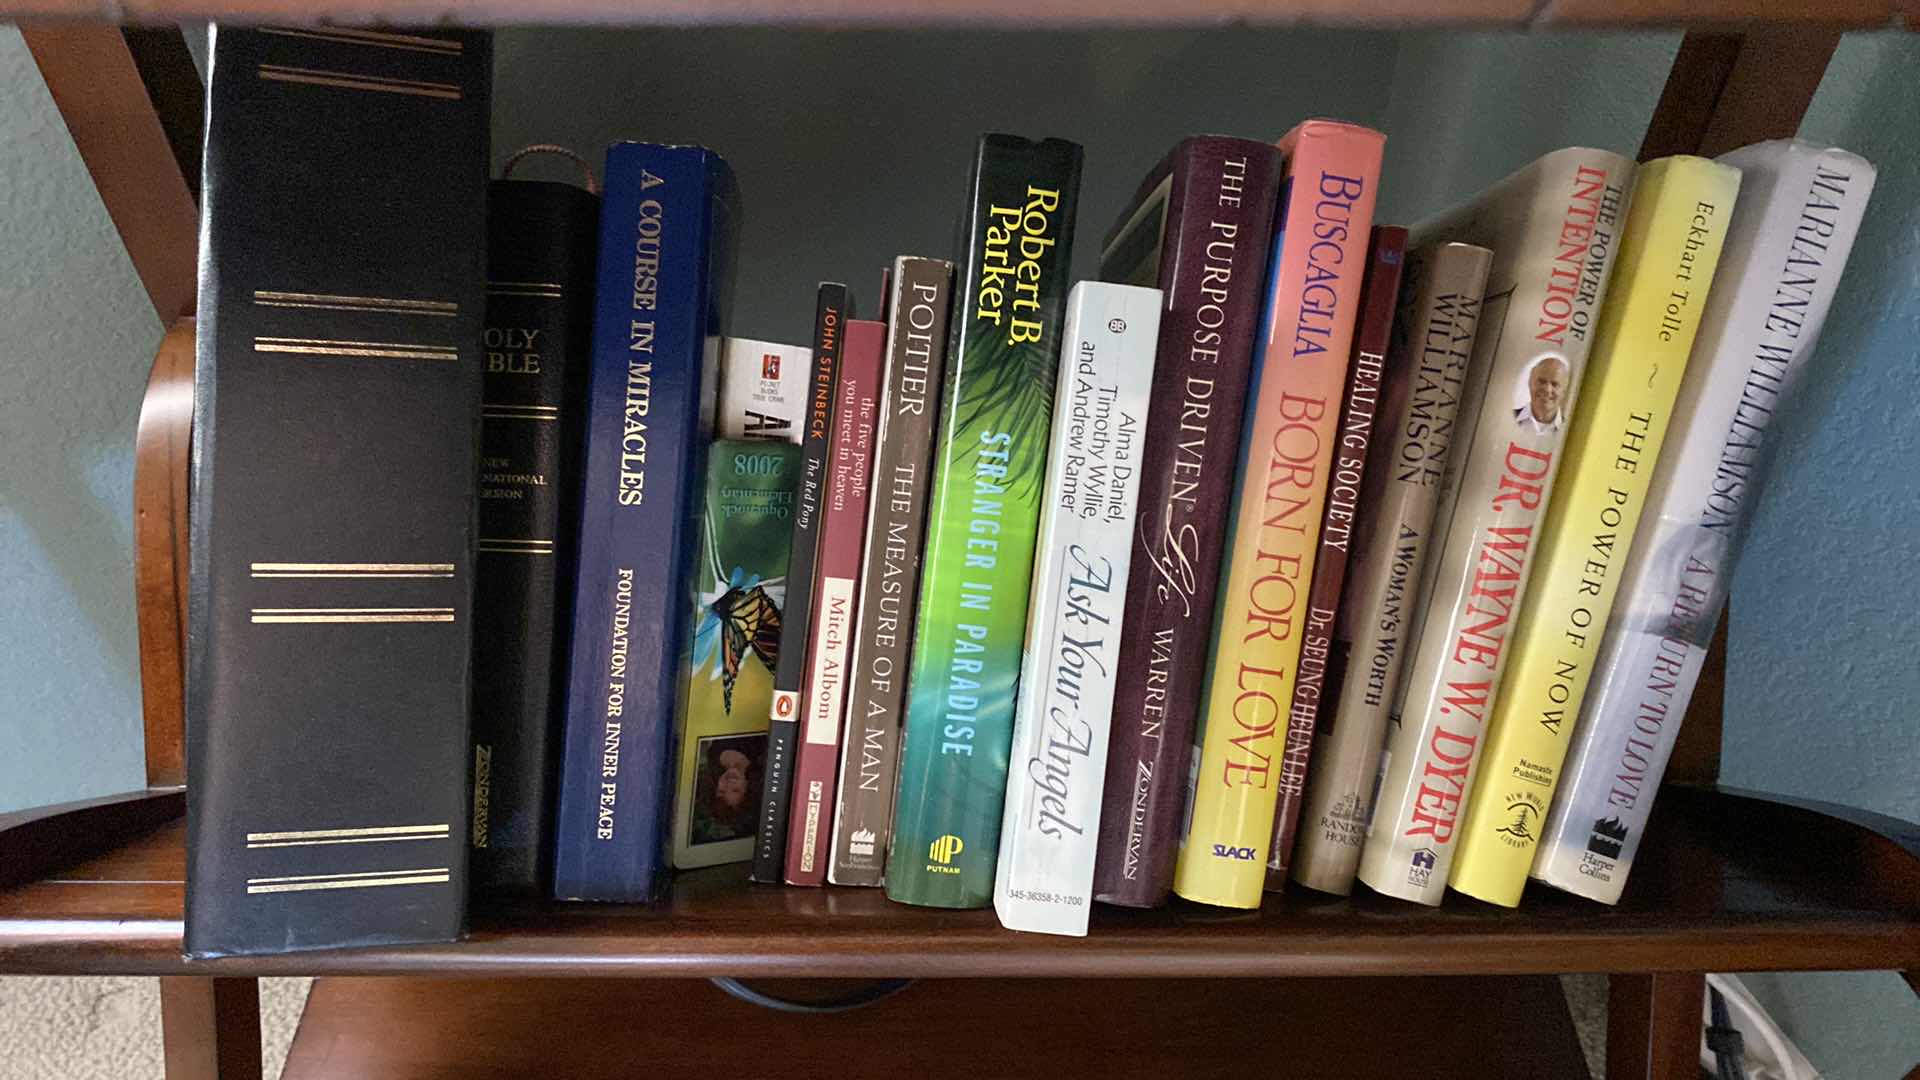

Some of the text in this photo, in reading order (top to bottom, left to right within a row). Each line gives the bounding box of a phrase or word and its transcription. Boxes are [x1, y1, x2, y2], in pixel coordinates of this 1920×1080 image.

[1219, 157, 1247, 208] THE
[977, 204, 1023, 326] Parker
[1008, 184, 1060, 346] Robert B.
[1190, 221, 1238, 364] PURPOSE
[1535, 164, 1607, 347] INTENTION
[1569, 185, 1622, 341] THE POWER OF
[1765, 163, 1850, 338] MARIANNE
[483, 327, 540, 350] OLY
[487, 352, 541, 374] BLE
[618, 169, 664, 506] A COURSE IN MIRACLES
[1396, 292, 1458, 485] WILLIAMSON
[1422, 294, 1478, 487] MARIANNE
[734, 454, 784, 477] 2008
[797, 307, 837, 529] JOHN STEINBECK The Red Pony
[834, 380, 857, 511] you meet in heaven
[851, 397, 875, 497] the five people
[1061, 340, 1096, 513] and Andrew Ramer
[1079, 386, 1118, 520] Timothy Wyllie,
[1103, 411, 1136, 523] Alma Daniel,
[1223, 170, 1363, 790] BUSCAGLIA BORN FOR LOVE
[1324, 351, 1383, 552] HEALING SOCIETY
[1540, 200, 1715, 736] Eckhart Tolle THE POWER OF NOW
[1700, 343, 1793, 538] WILLIAMSON
[859, 281, 937, 792] POITIER THE MEASURE OF A MAN
[941, 429, 1011, 758] STRANGER IN PARADISE
[1140, 503, 1199, 618] Life
[1685, 555, 1715, 577] A
[818, 596, 846, 720] Mitch Albom
[1295, 635, 1328, 700] SEUNG
[1308, 606, 1334, 635] Dr.
[1364, 522, 1419, 708] A WOMAN'S WORTH
[1405, 441, 1553, 845] DR. WAYNE W. DYER
[597, 568, 633, 840] FOUNDATION FOR INNER PEACE
[1028, 544, 1112, 840] Ask Your Angels
[1141, 628, 1174, 739] WARREN
[1633, 700, 1669, 737] TO
[473, 744, 492, 849] ZONDERVAN
[763, 739, 784, 859] PENGUIN CLASSICS
[1125, 760, 1153, 880] ZONDERVAN
[1607, 740, 1654, 811] LOVE
[926, 864, 961, 875] PUTNAM
[1212, 844, 1256, 860] SLACK
[1578, 864, 1611, 883] Collins
[1582, 852, 1615, 871] Harper
